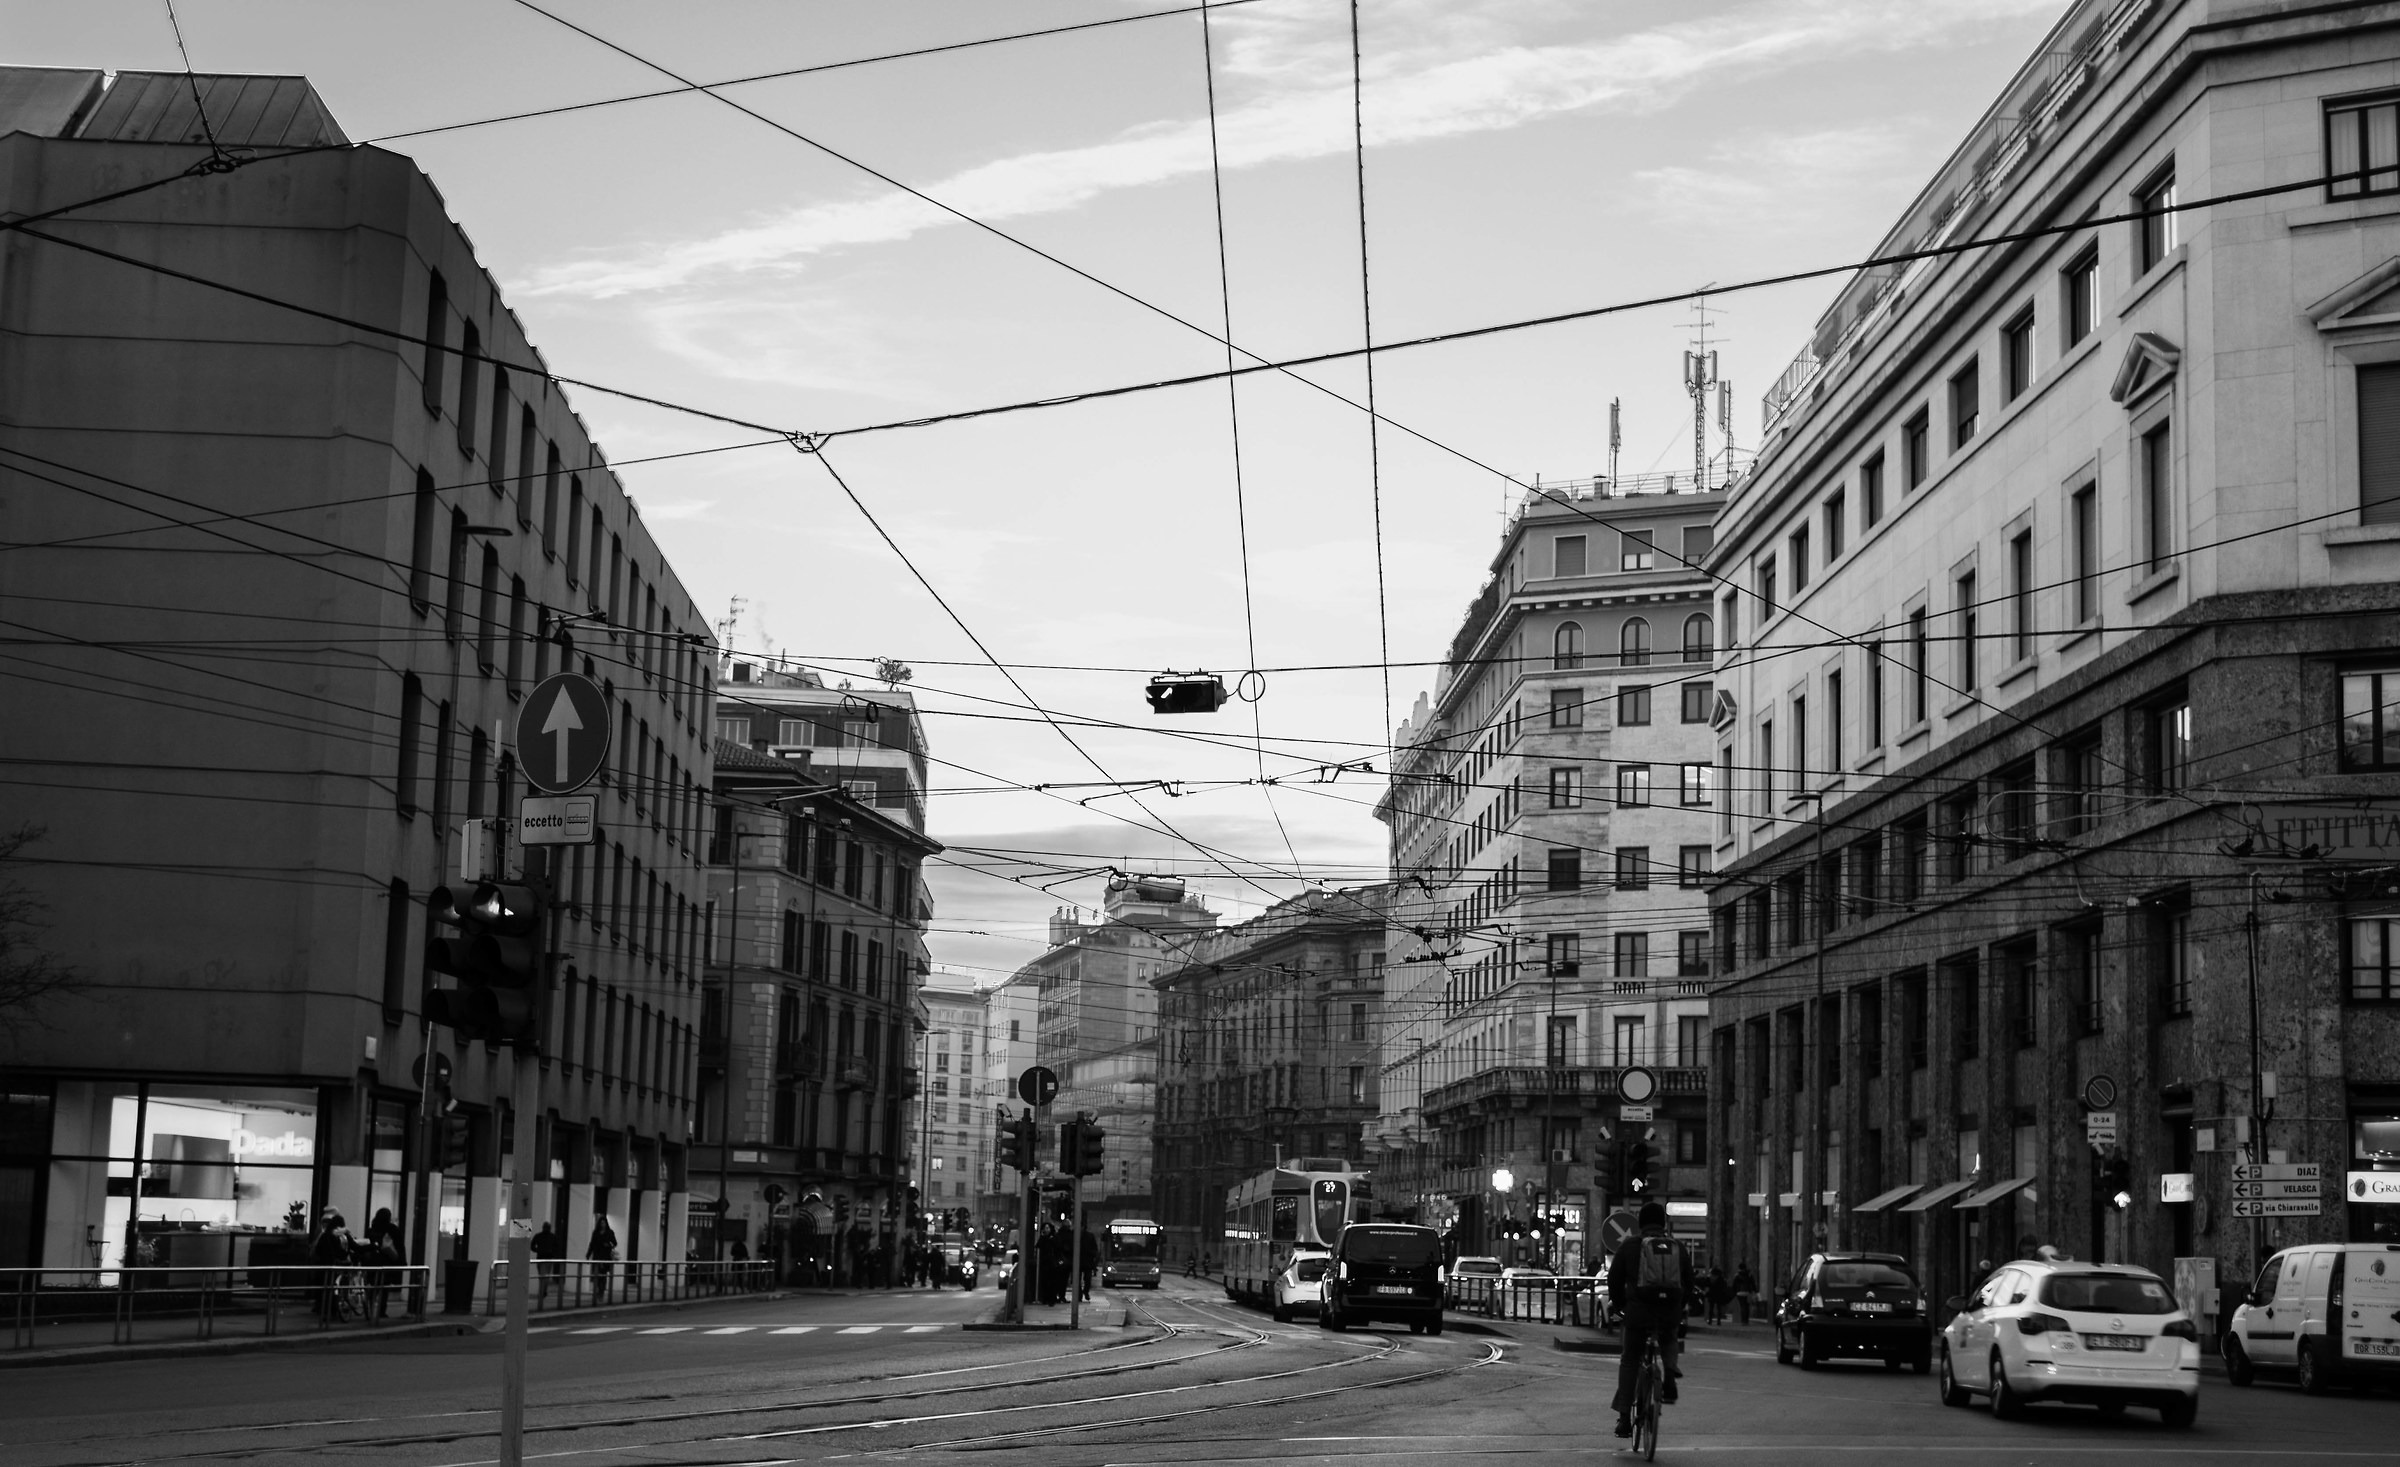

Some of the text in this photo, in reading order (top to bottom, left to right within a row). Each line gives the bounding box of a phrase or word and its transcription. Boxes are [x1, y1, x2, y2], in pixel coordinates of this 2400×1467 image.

[524, 814, 563, 828] eccetto
[230, 1130, 313, 1157] Dada
[2297, 1167, 2317, 1176] DIAZ
[2283, 1185, 2317, 1193] VELASCA
[2372, 1180, 2400, 1194] GRA
[2265, 1204, 2276, 1212] via
[2277, 1203, 2319, 1212] Chiaravallo
